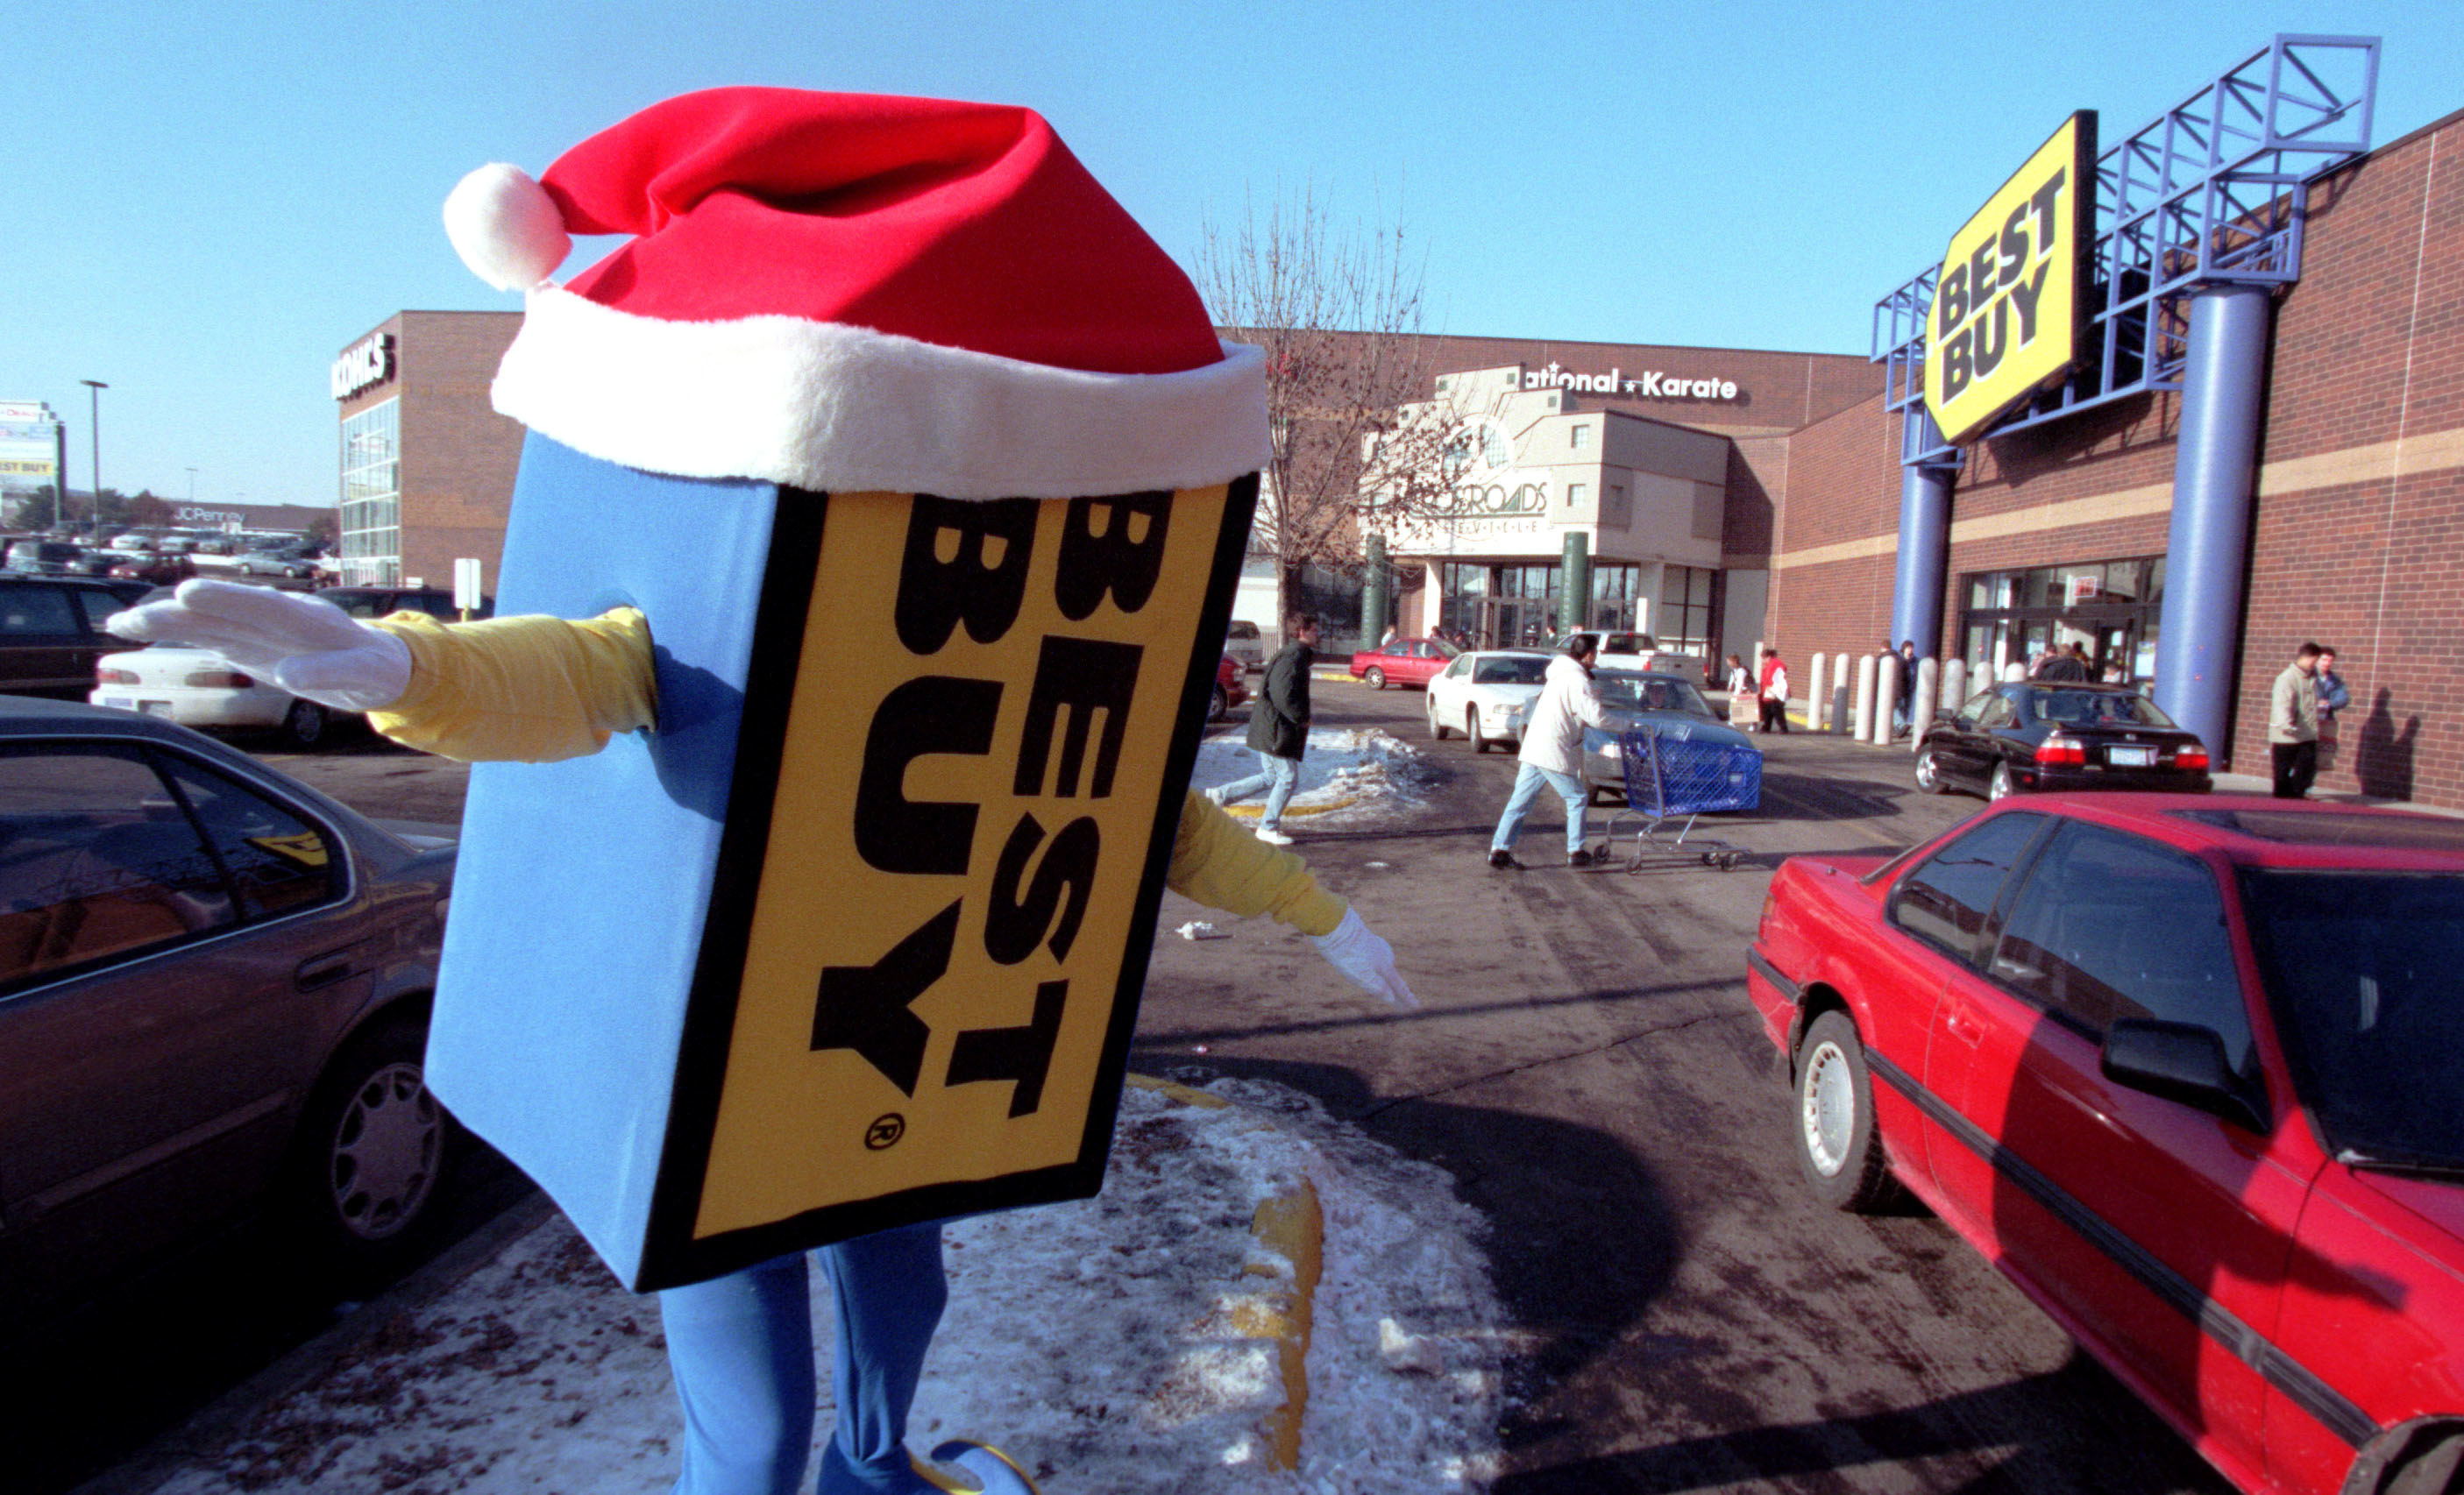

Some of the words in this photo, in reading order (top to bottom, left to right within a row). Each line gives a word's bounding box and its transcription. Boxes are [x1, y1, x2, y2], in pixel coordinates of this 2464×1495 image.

[1939, 165, 2065, 343] BEST
[1942, 257, 2052, 406] BUY
[1643, 372, 1737, 399] Karate
[22, 463, 49, 472] BUY
[810, 497, 1041, 1099] BUY
[946, 489, 1175, 1120] BEST
